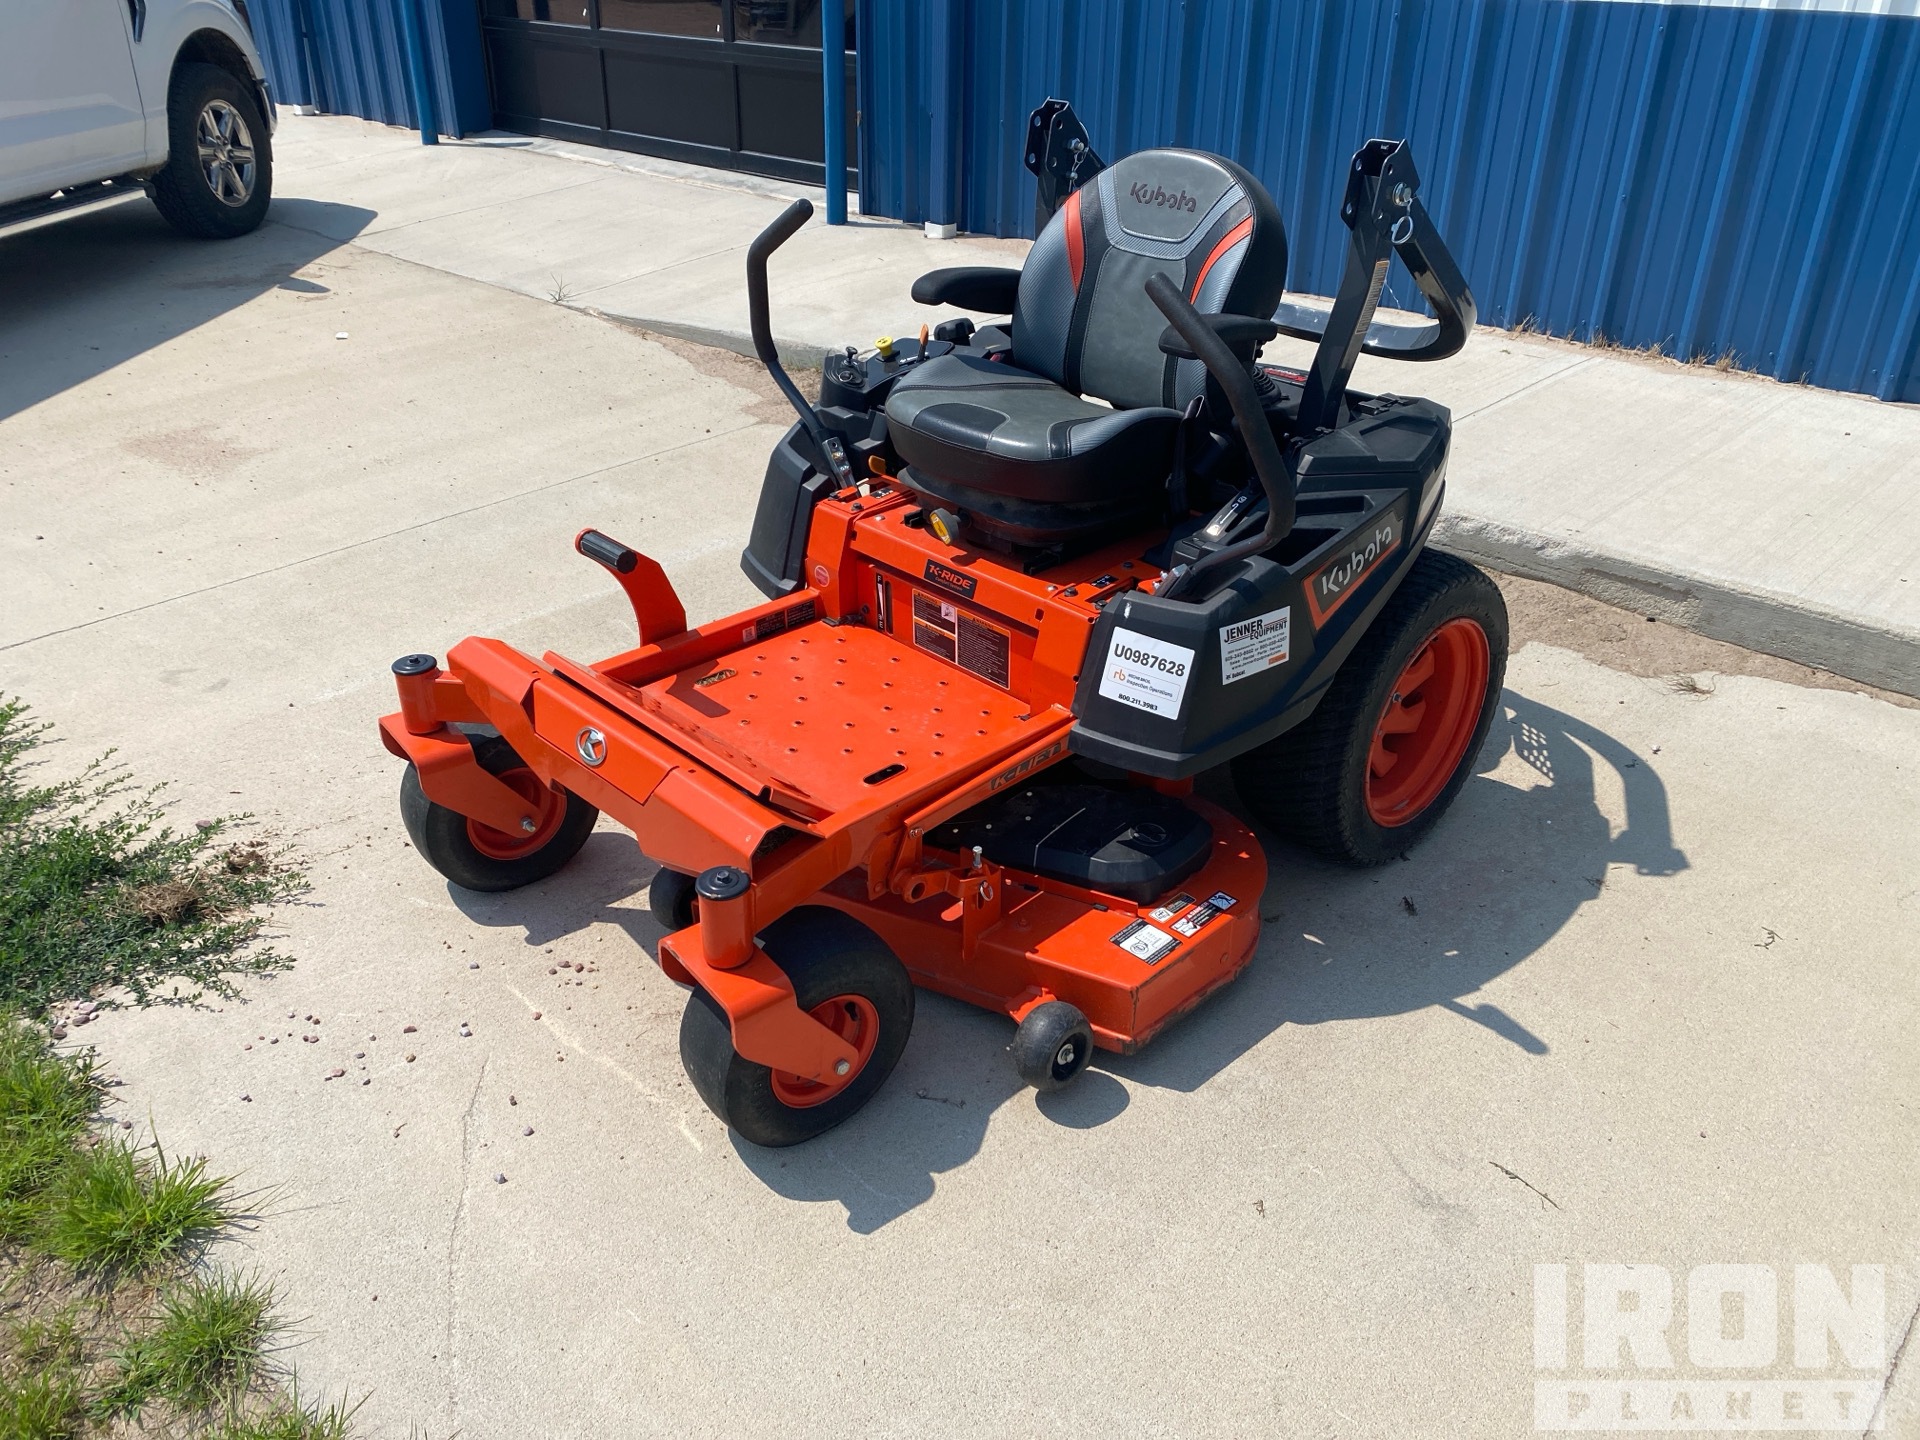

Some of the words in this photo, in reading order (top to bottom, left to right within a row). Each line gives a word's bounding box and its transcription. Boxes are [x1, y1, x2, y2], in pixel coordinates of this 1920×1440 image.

[1130, 182, 1197, 212] Kubota
[1321, 526, 1392, 595] Kubota
[928, 564, 973, 590] K-RIDE
[1224, 619, 1263, 643] JENNER
[1250, 620, 1287, 640] EQUIPMENT
[1114, 643, 1186, 677] U0987628
[1117, 693, 1158, 711] 800.211.3983
